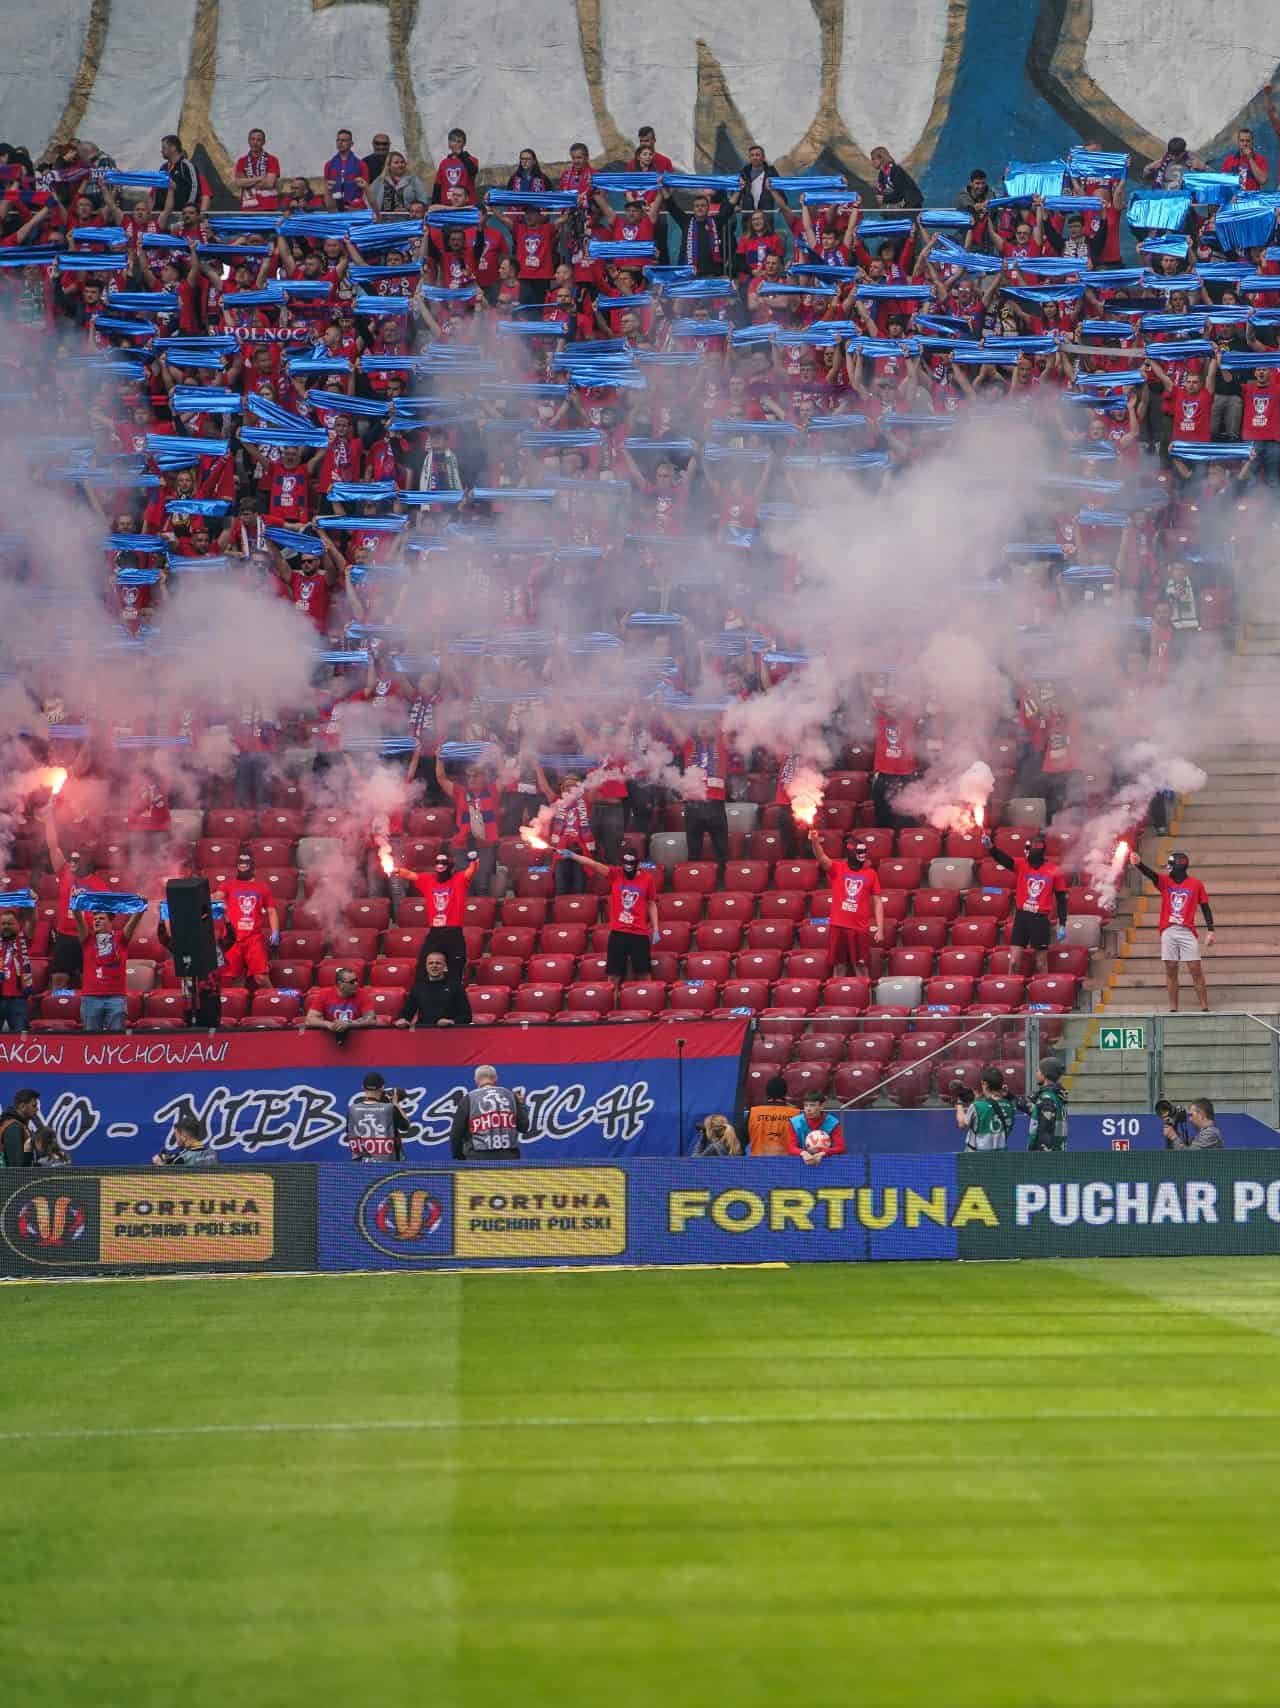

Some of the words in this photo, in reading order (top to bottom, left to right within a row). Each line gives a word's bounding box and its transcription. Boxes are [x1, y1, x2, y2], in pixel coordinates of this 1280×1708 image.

[84, 1041, 230, 1065] WYCHOWANI
[1102, 1118, 1140, 1136] S10
[350, 1139, 394, 1154] PHOTO
[484, 1134, 511, 1150] 185
[114, 1200, 259, 1216] FORTUNA
[469, 1193, 611, 1211] FORTUNA
[667, 1184, 1000, 1234] FORTUNA
[1015, 1181, 1219, 1226] PUCHAR
